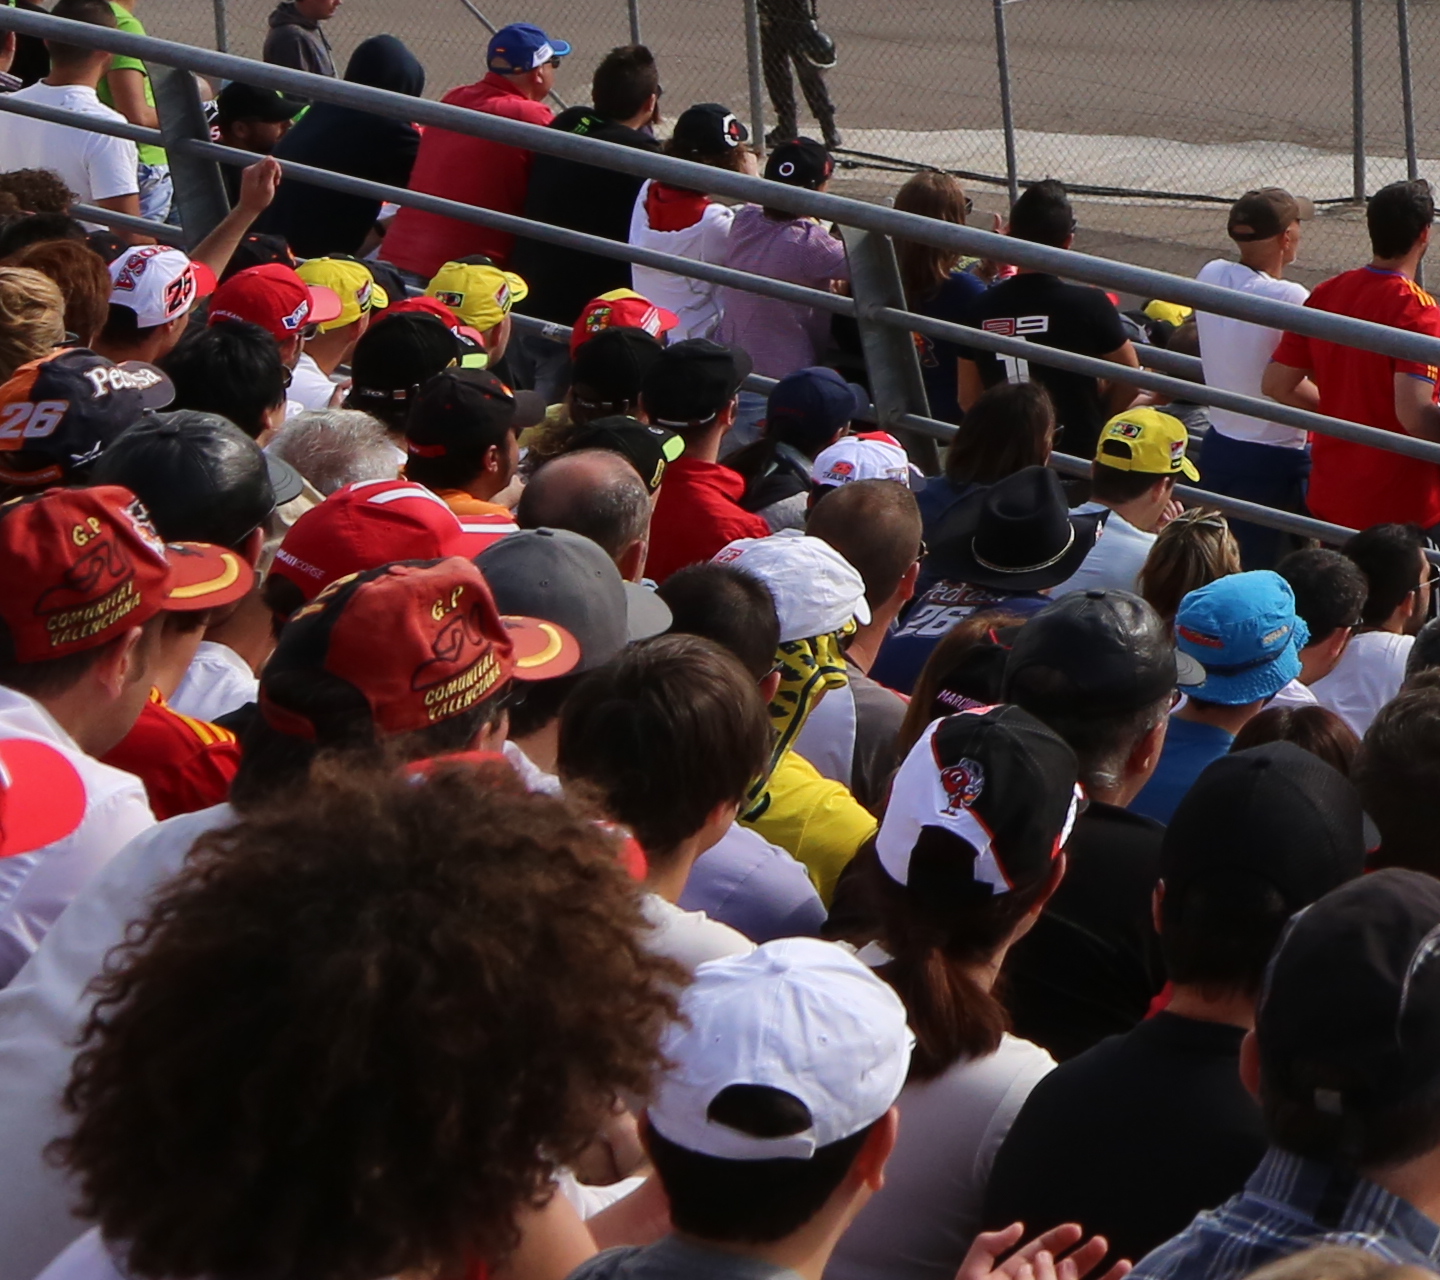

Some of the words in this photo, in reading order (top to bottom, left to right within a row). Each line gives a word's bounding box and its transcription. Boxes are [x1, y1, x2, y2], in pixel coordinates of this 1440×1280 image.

[0, 399, 70, 439] 26
[50, 591, 141, 647] VALENCIANA
[893, 604, 976, 638] 26
[428, 661, 502, 721] VALENCIANA
